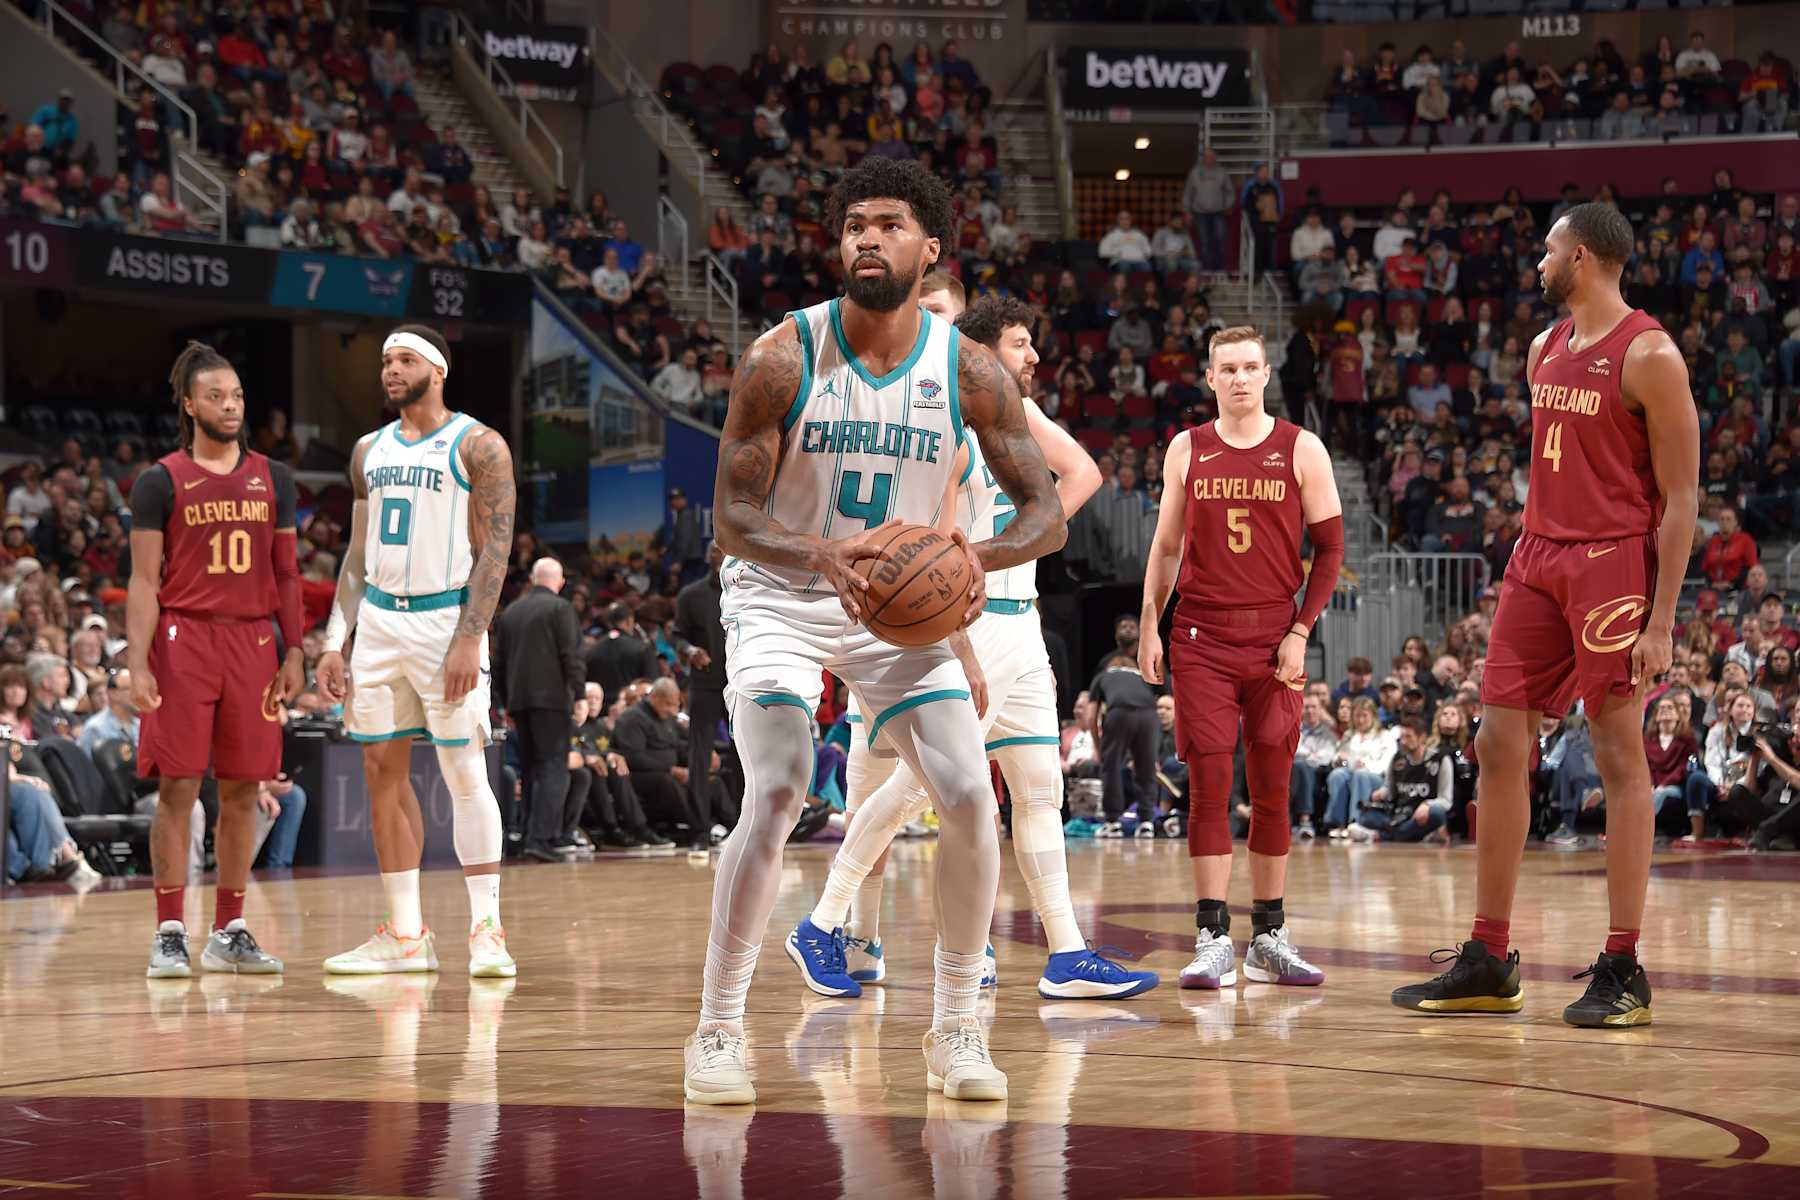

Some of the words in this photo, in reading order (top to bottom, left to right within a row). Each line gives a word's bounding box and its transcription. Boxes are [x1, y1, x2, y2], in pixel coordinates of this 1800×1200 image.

[783, 19, 928, 38] CHAMPIONS
[941, 22, 1003, 39] CLUB
[1522, 14, 1580, 38] M113
[485, 30, 577, 69] betway
[1086, 52, 1228, 98] betway
[6, 231, 49, 273] 10
[106, 247, 230, 287] ASSISTS
[303, 262, 326, 300] 7
[433, 289, 464, 317] 32
[802, 420, 942, 464] CHARLOTTE
[1542, 421, 1563, 472] 4
[836, 471, 893, 530] 4
[1193, 478, 1287, 502] CLEVELAND
[184, 500, 269, 527] CLEVELAND
[380, 498, 412, 546] 0
[1227, 508, 1252, 554] 5
[207, 529, 252, 574] 10
[875, 532, 945, 585] Wilson
